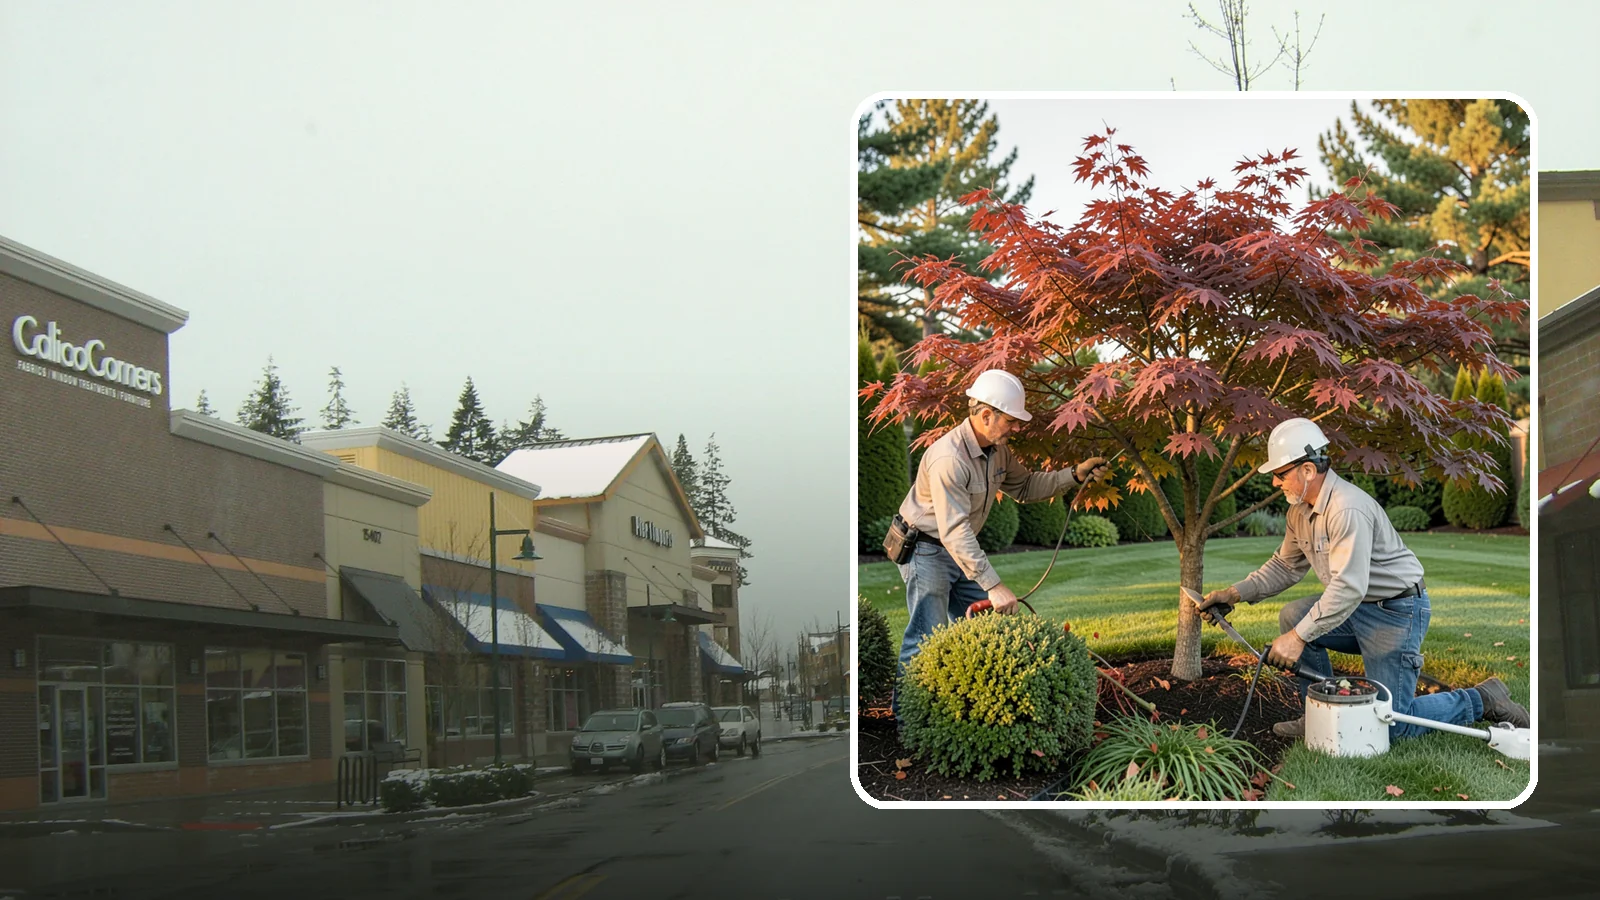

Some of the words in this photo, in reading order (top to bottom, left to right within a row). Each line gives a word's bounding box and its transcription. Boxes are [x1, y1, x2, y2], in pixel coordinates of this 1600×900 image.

[17, 360, 47, 377] FABRICS
[51, 370, 78, 386] WINDOW
[79, 379, 117, 398] TREATMENTS
